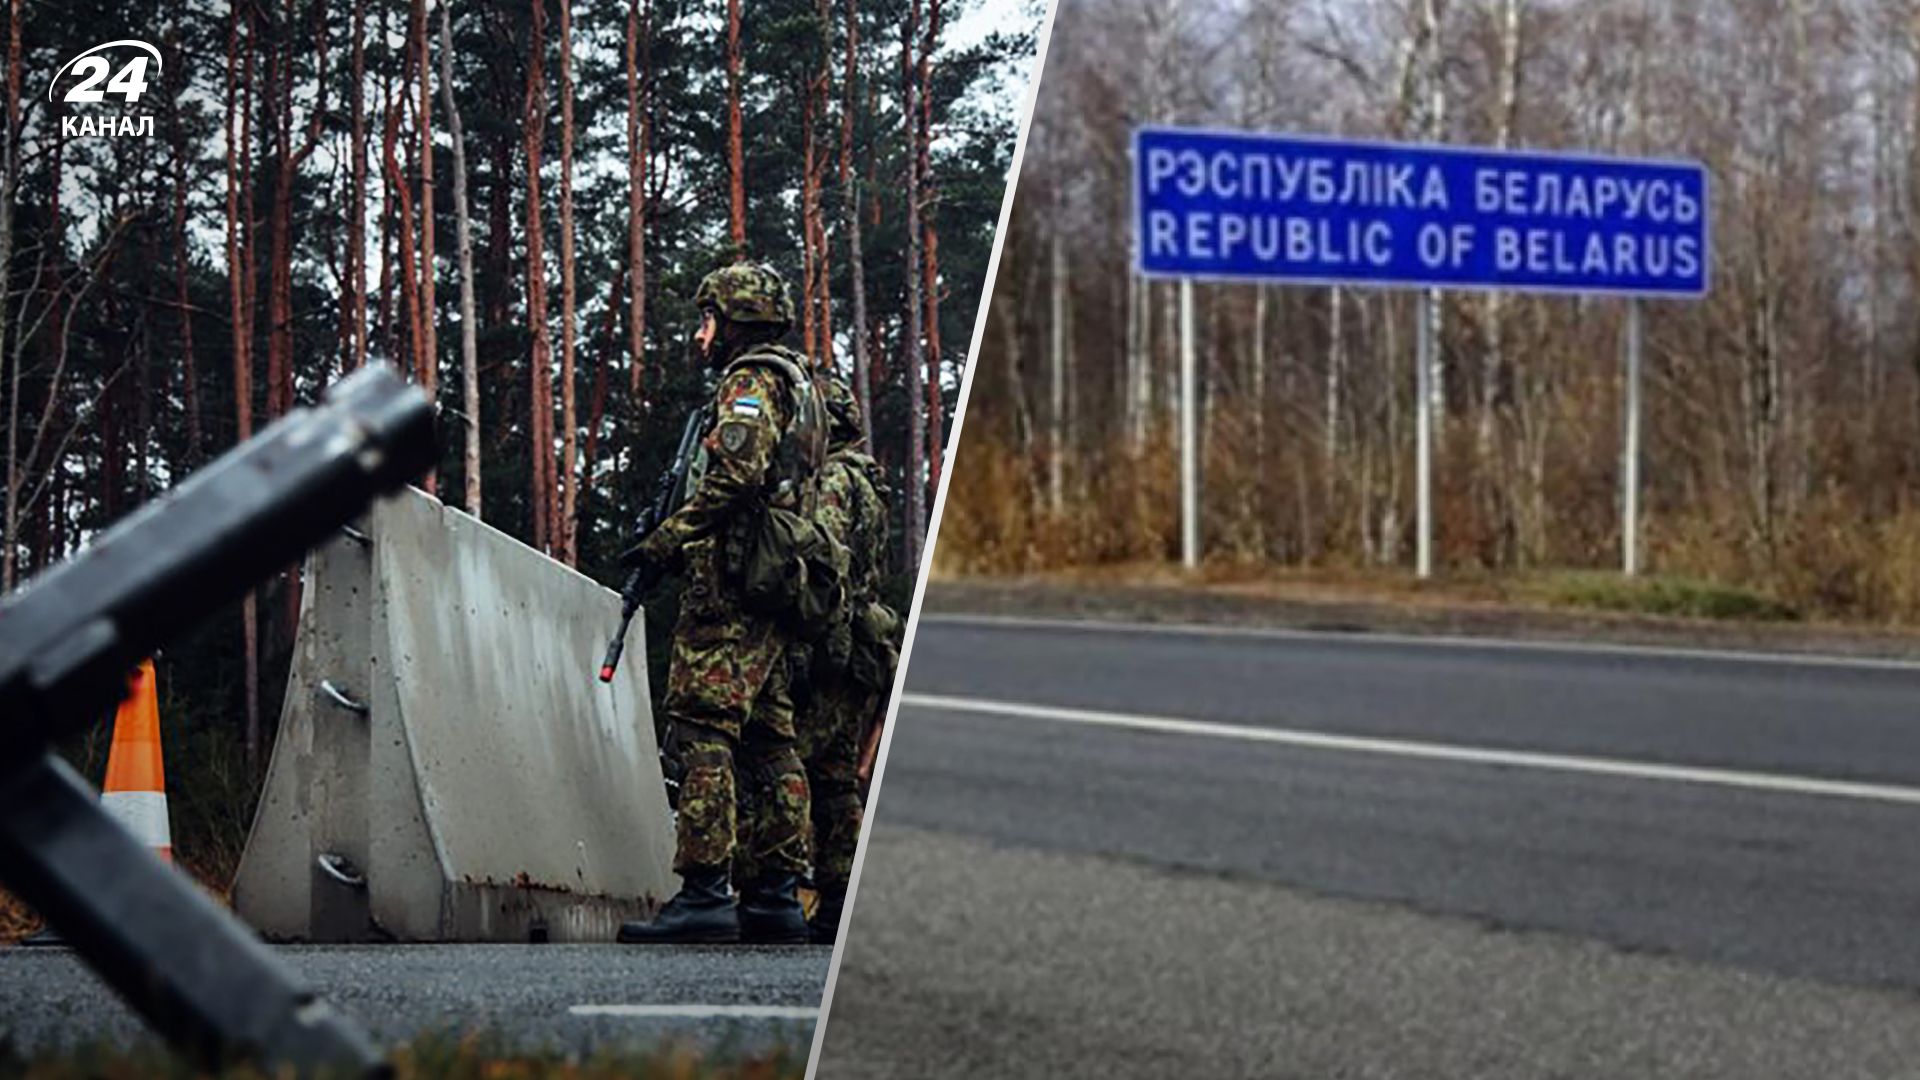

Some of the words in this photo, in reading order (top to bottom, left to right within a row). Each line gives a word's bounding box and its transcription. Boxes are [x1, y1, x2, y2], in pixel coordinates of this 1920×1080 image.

[1148, 148, 1449, 210] РЭСПУБЛІКА
[1475, 167, 1699, 224] БЕЛАРУСЬ
[1149, 209, 1393, 265] REPUBLIC
[1417, 223, 1475, 269] OF
[1495, 227, 1699, 278] BELARUS
